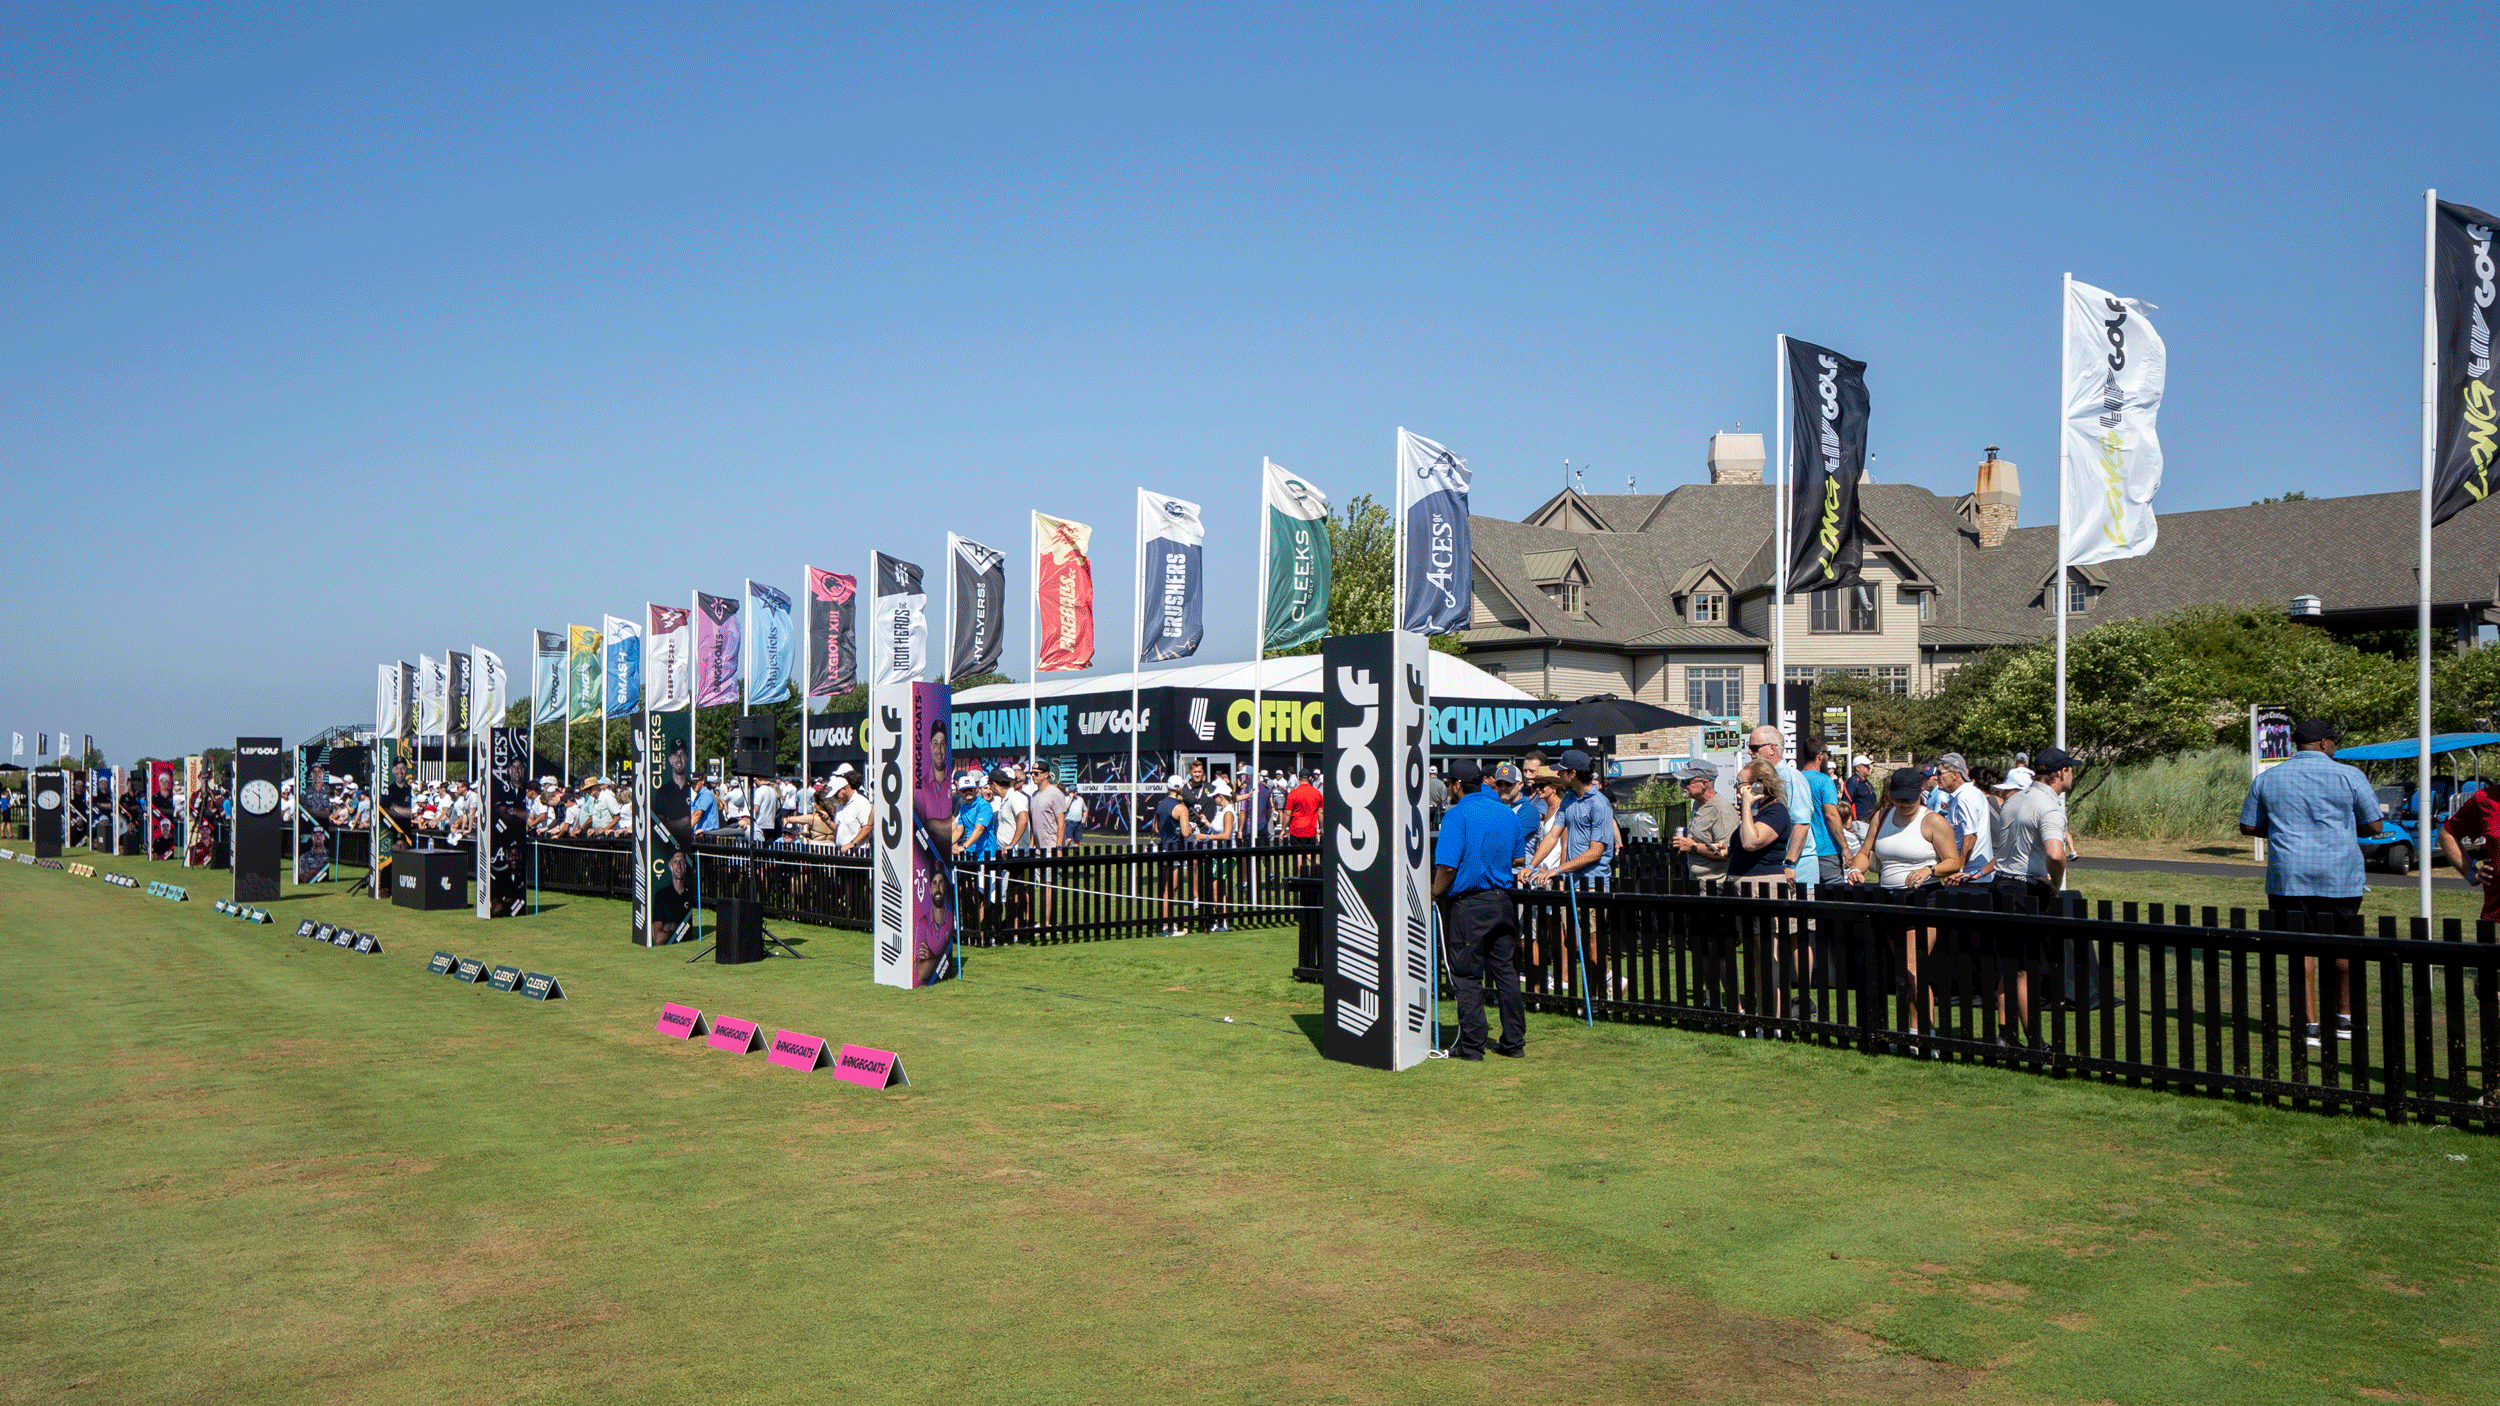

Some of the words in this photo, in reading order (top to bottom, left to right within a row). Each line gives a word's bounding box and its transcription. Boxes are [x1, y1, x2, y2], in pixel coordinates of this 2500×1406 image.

[1163, 553, 1186, 638] CRUSHERS
[1292, 530, 1309, 622] CLEEKS
[830, 610, 840, 632] XIII
[894, 610, 910, 644] HEADS
[974, 589, 985, 664] HYFLYERS
[1060, 575, 1076, 653] FIREBALLS
[618, 652, 628, 704] SMASH
[714, 634, 723, 692] RANGEGOATS
[768, 626, 779, 688] Majesticks
[828, 634, 839, 680] LEGION
[894, 647, 909, 671] IRON
[550, 664, 559, 711] TORQUE
[828, 727, 853, 746] GOLF
[952, 705, 1068, 750] ERCHANDISE
[1227, 699, 1323, 743] OFFIC
[1429, 706, 1572, 746] RCHAND
[381, 746, 389, 796] STINGER
[492, 736, 508, 793] ACES
[652, 714, 662, 789] CLEEKS
[1337, 666, 1379, 872] GOLF
[1406, 663, 1424, 870] GOLF
[635, 729, 645, 841] GOLF
[882, 705, 902, 850] GOLF
[433, 955, 450, 967] CLEEKS
[460, 962, 479, 975] CLEEKS
[494, 970, 515, 983] CLEEKS
[527, 977, 549, 991] CLEEKS
[663, 1012, 692, 1027] RANGEGOATS
[715, 1025, 748, 1042] RANGEGOATS
[776, 1040, 814, 1058] RANGEGOATS
[842, 1055, 885, 1074] RANGEGOATS
